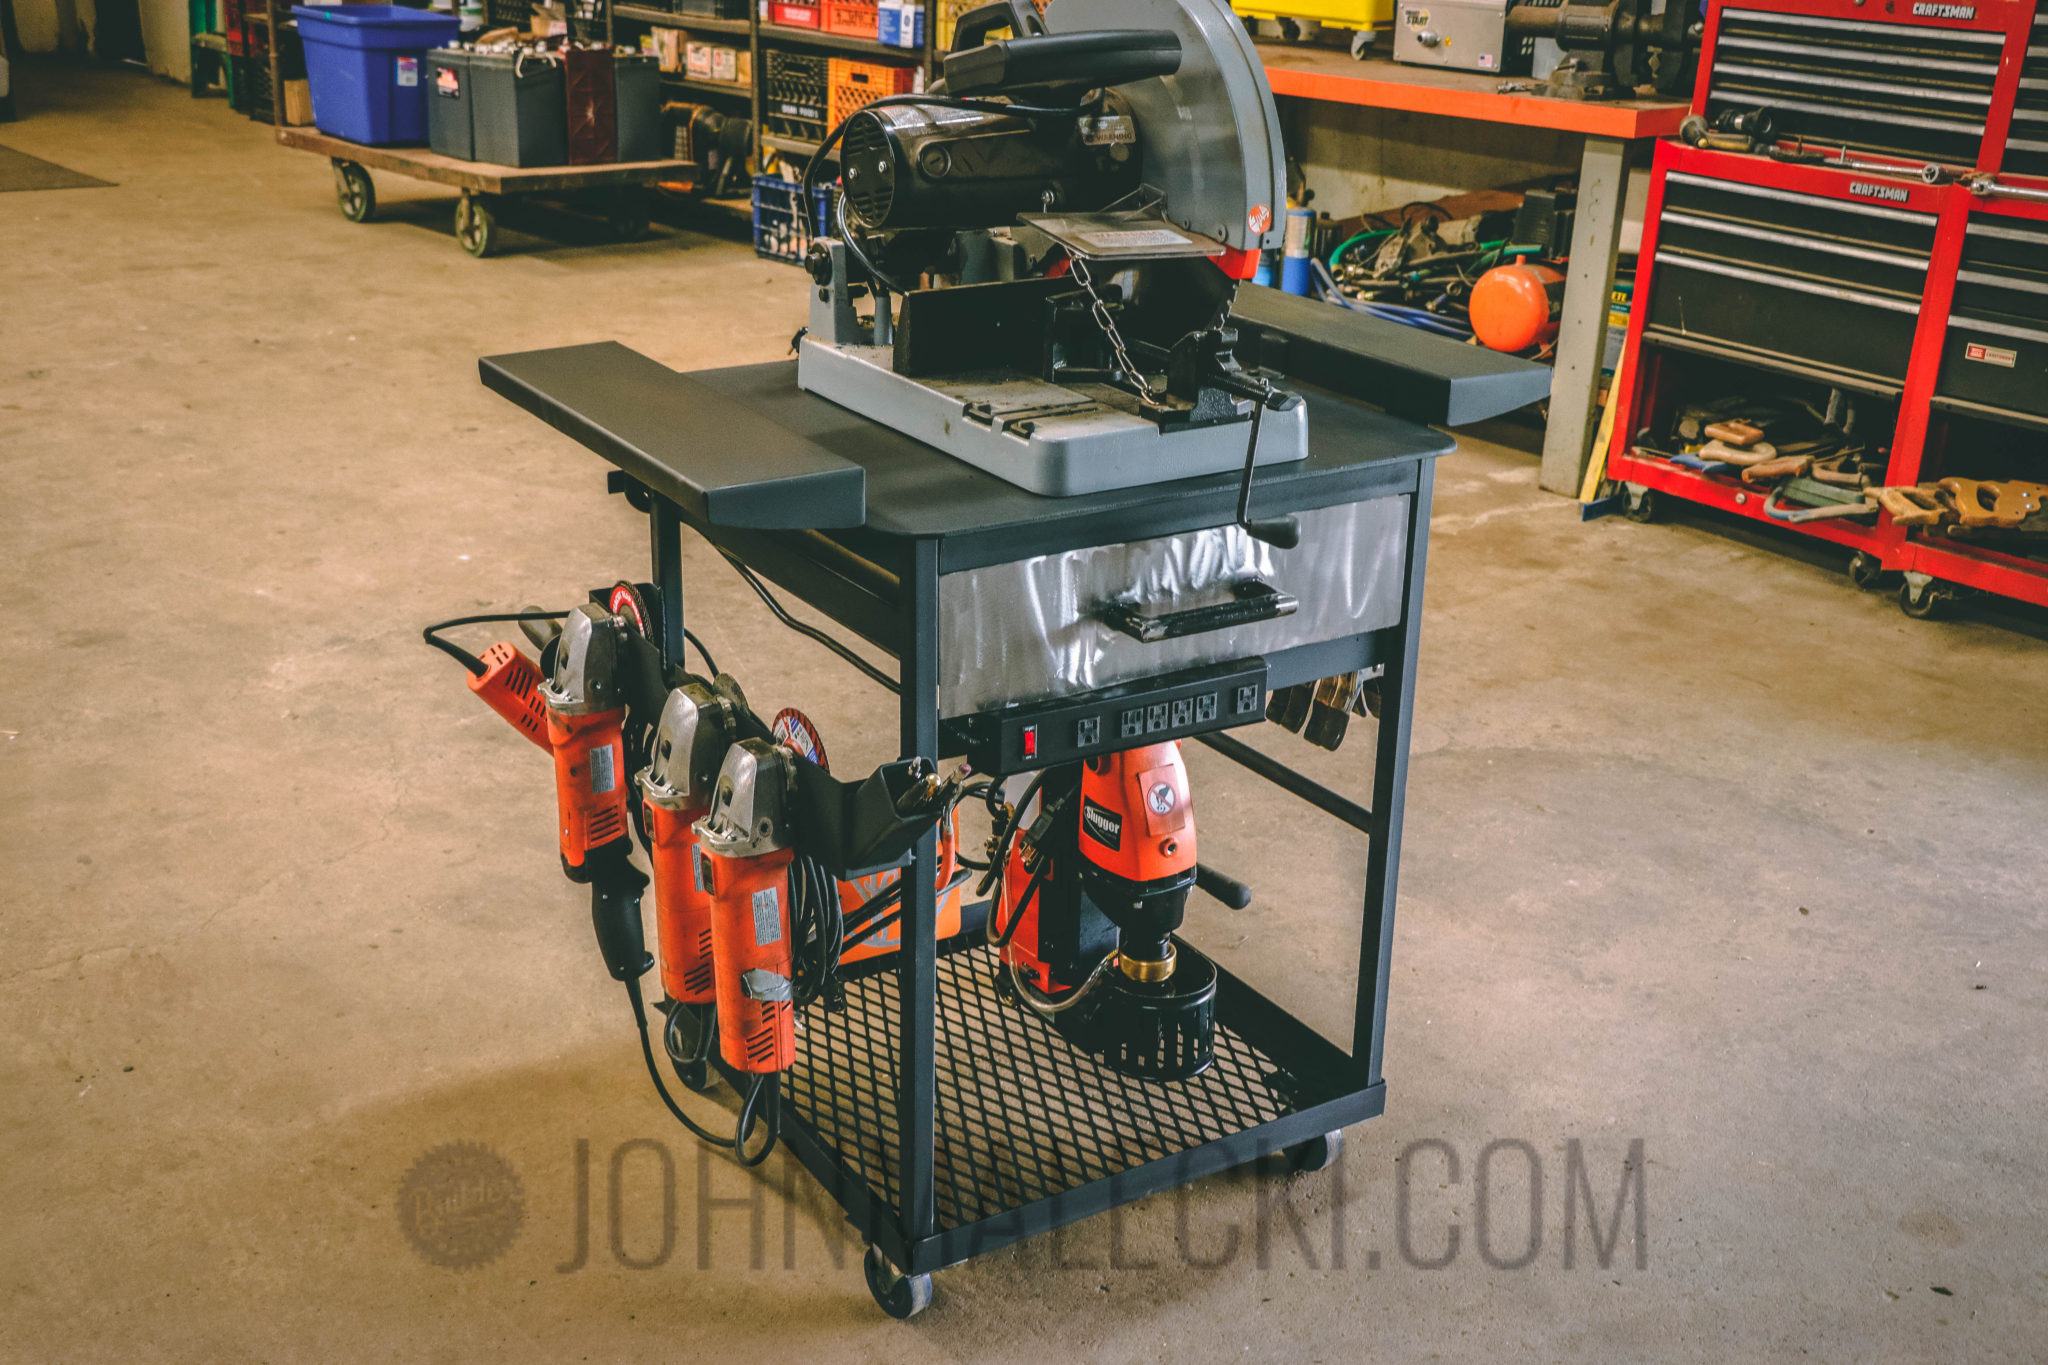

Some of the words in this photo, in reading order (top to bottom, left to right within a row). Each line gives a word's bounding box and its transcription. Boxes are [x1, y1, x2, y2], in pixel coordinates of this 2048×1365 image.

[1406, 15, 1429, 26] START
[1911, 2, 1976, 20] CRAFTSMAN
[1849, 181, 1910, 203] CRAFTSMAN
[1085, 805, 1121, 835] Slugger
